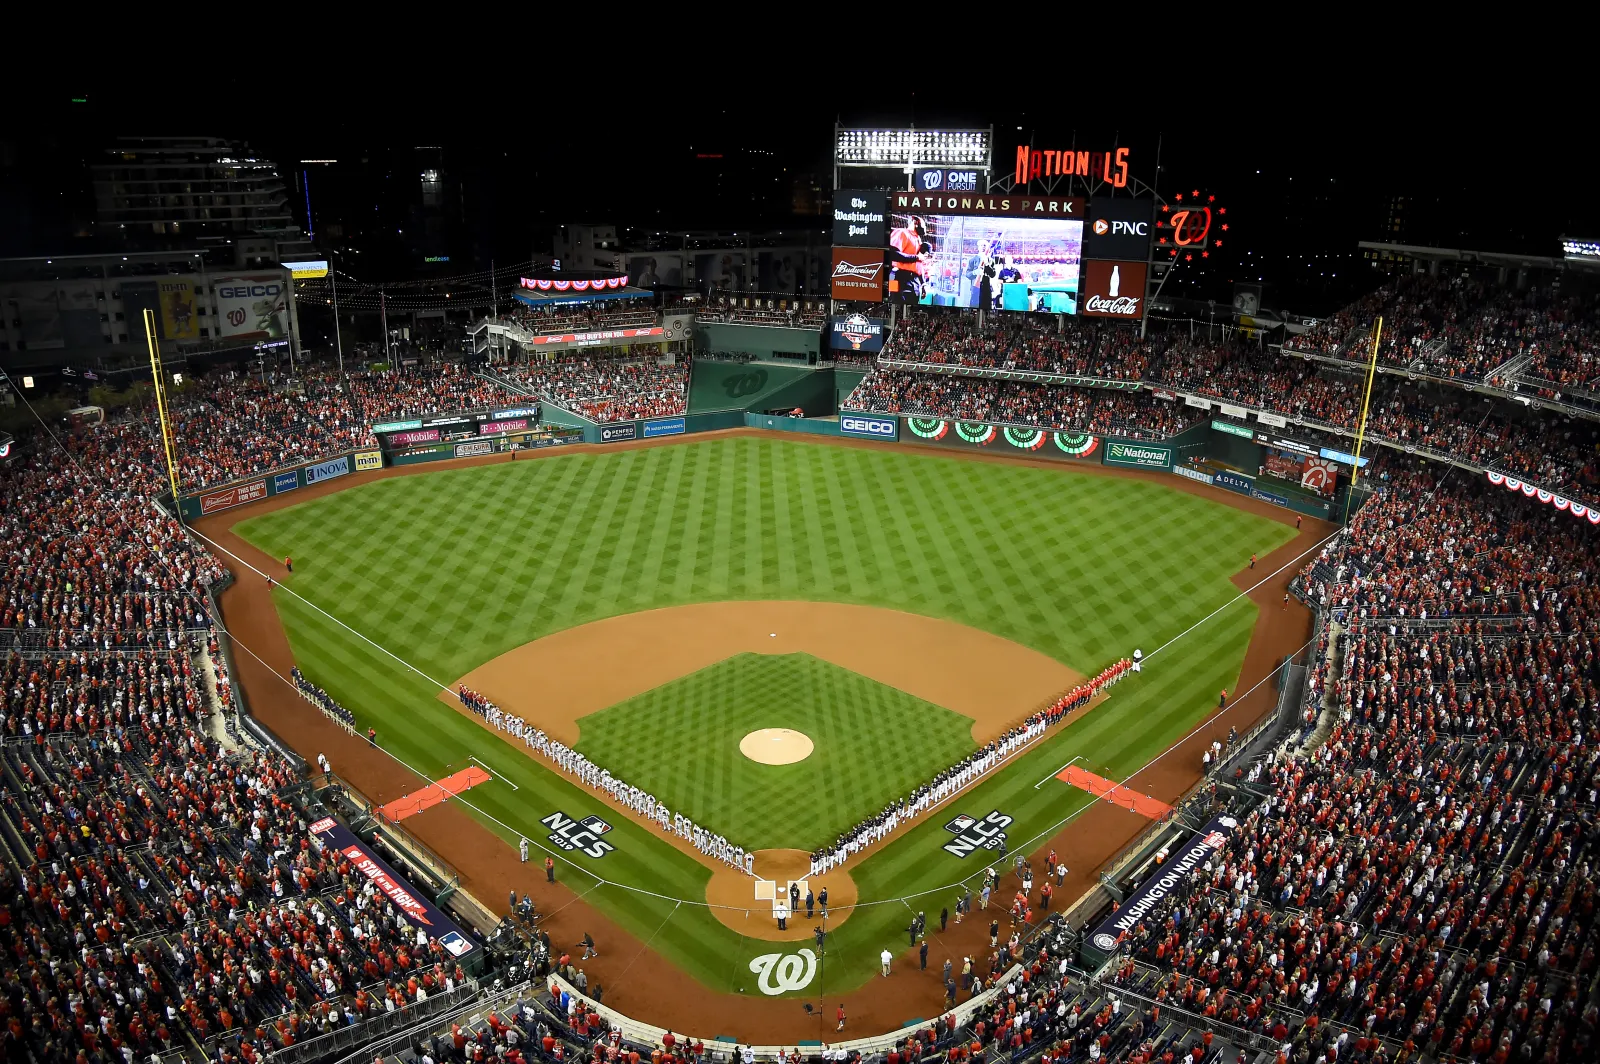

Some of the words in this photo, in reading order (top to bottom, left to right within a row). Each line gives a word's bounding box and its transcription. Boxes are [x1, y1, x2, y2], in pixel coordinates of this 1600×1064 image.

[1016, 145, 1130, 188] NATIONALS
[948, 172, 977, 183] ONE
[947, 182, 976, 191] PURSUIT
[851, 198, 867, 209] The
[899, 196, 1010, 211] NATIONALS
[1022, 201, 1073, 213] PARK
[834, 209, 883, 223] Washington
[848, 225, 868, 236] Post
[1111, 221, 1148, 236] PNC
[835, 263, 877, 275] Budweiser
[219, 284, 280, 299] GEICO
[834, 323, 846, 332] ALL
[847, 324, 862, 333] STAR
[864, 325, 880, 334] GAME
[842, 418, 894, 434] GEICO
[1219, 424, 1235, 433] Harris
[1235, 428, 1252, 437] Teeter
[1123, 447, 1167, 461] National
[317, 462, 348, 478] INOVA
[238, 487, 249, 495] THIS
[250, 483, 265, 491] BUD'S
[276, 477, 297, 487] RE/MAX
[1223, 477, 1249, 489] DELTA
[238, 494, 249, 502] FOR
[541, 812, 614, 858] NLCS
[943, 810, 1013, 858] NLCS
[983, 832, 1006, 850] 2019
[548, 834, 574, 850] 2019
[358, 859, 385, 882] STAY
[377, 876, 386, 884] IN
[383, 881, 394, 890] THE
[1113, 871, 1181, 931] WASHINGTON
[1172, 841, 1212, 875] NATION
